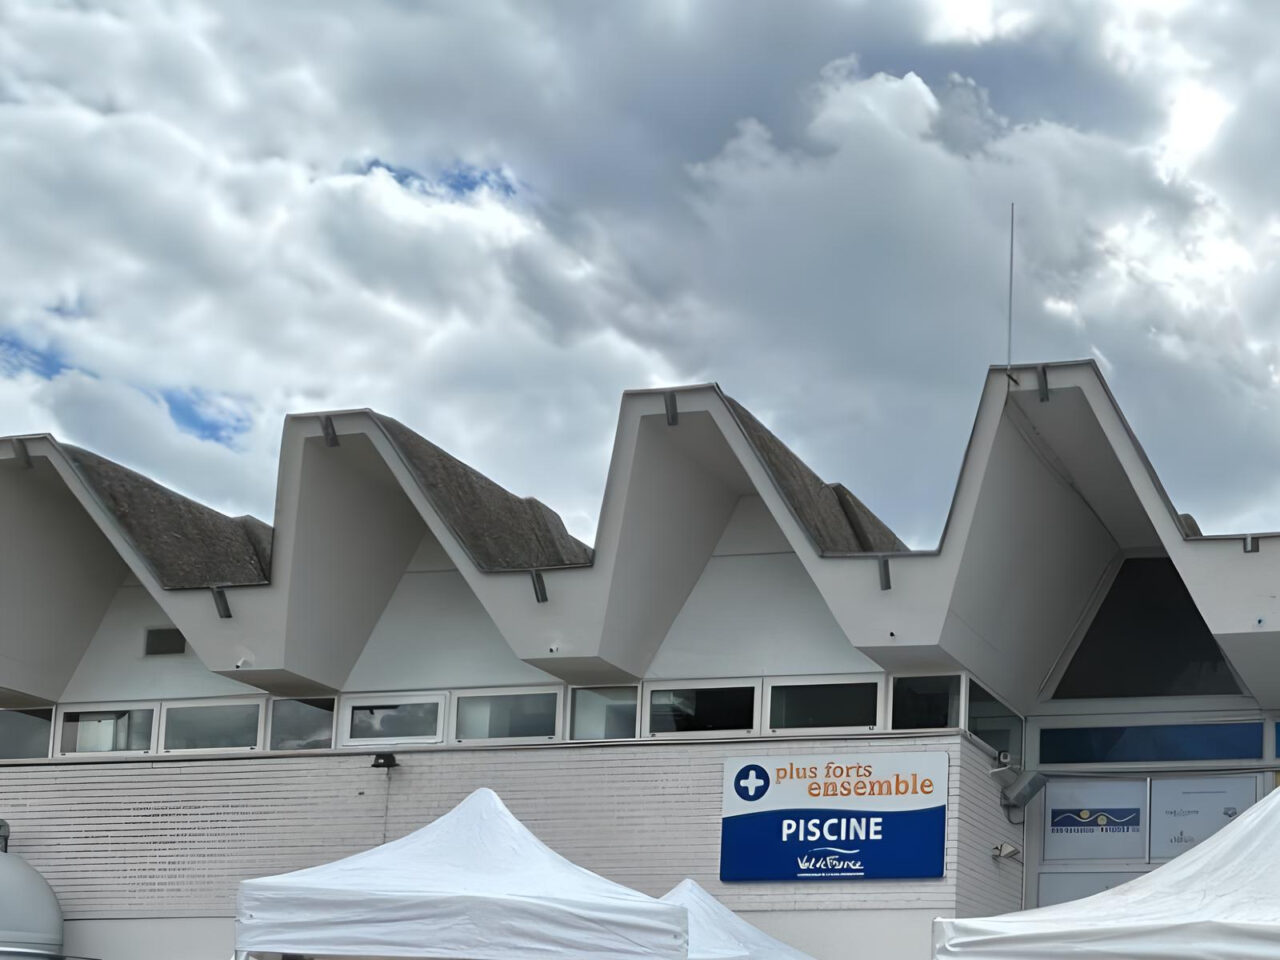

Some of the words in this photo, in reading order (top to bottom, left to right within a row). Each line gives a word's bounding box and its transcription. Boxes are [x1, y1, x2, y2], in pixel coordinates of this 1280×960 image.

[775, 762, 818, 785] plus
[825, 761, 873, 778] forts
[808, 773, 934, 797] ensemble
[782, 817, 883, 841] PISCINE
